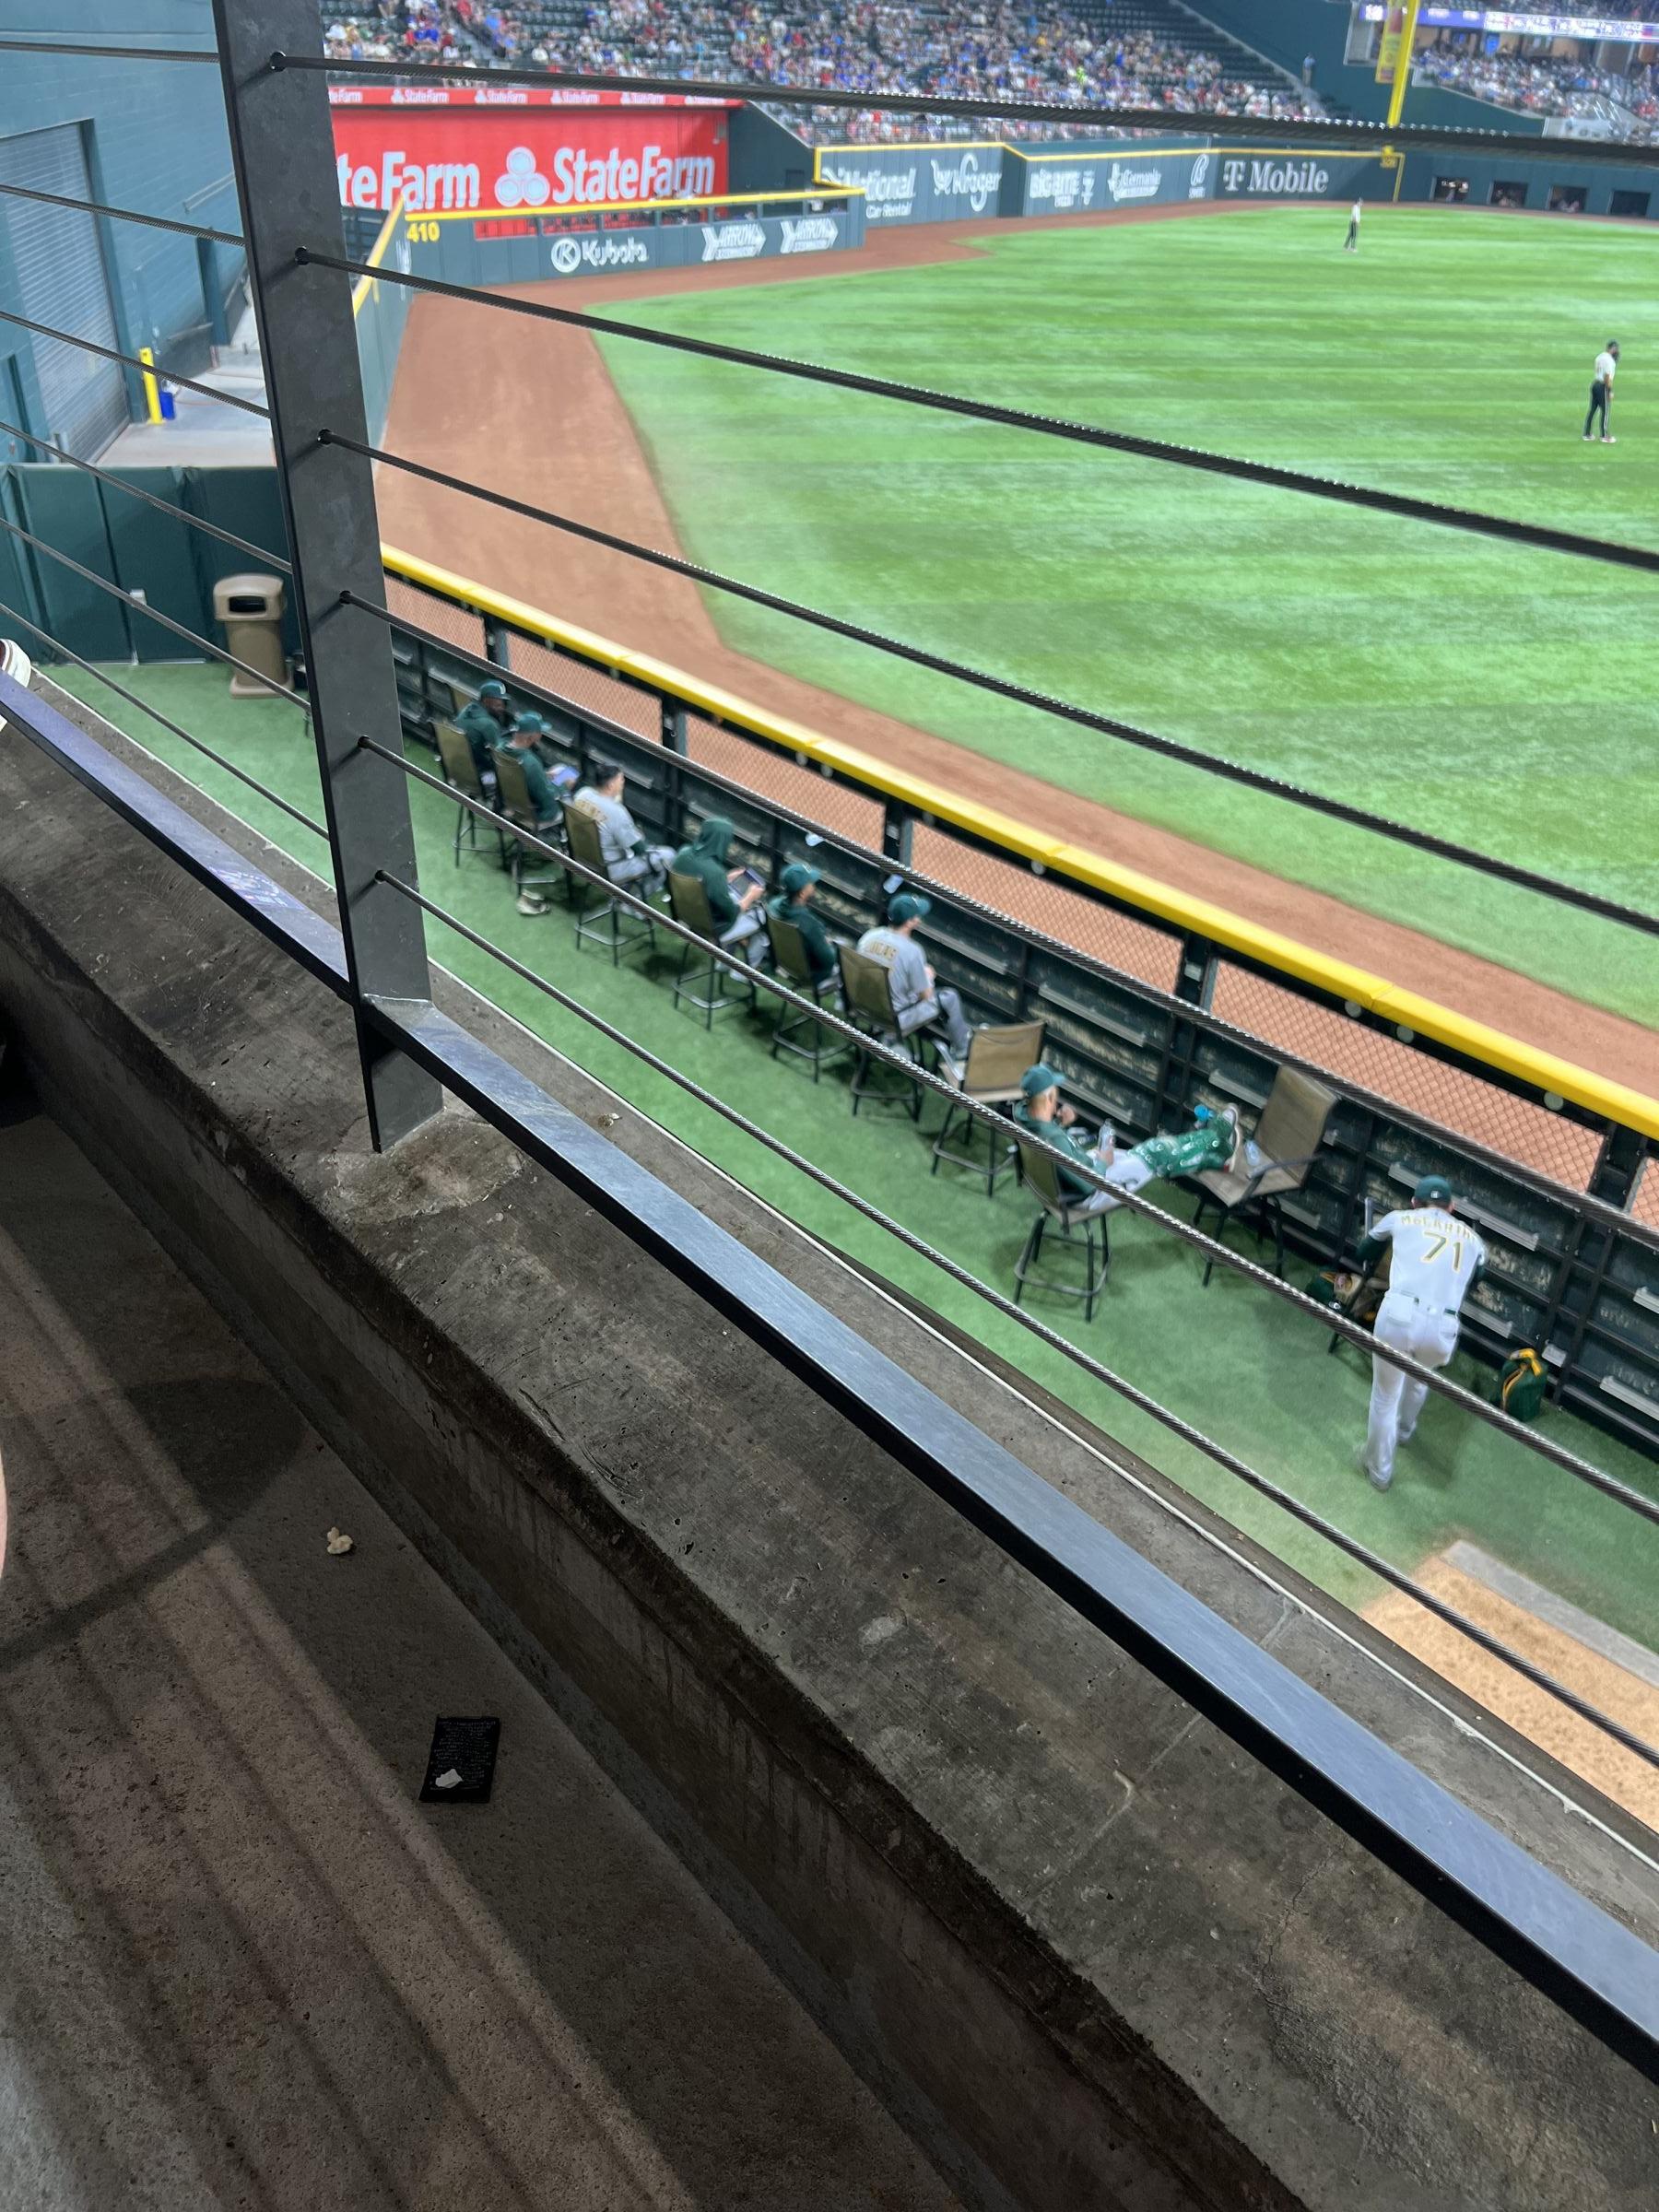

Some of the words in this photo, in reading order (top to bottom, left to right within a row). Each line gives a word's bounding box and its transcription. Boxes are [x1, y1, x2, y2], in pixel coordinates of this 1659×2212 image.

[552, 145, 715, 205] StateFarm
[952, 153, 1002, 212] Kroger
[1247, 161, 1329, 193] Mobile
[406, 221, 441, 242] 410
[582, 237, 649, 266] Kubota
[1421, 1230, 1464, 1274] 71
